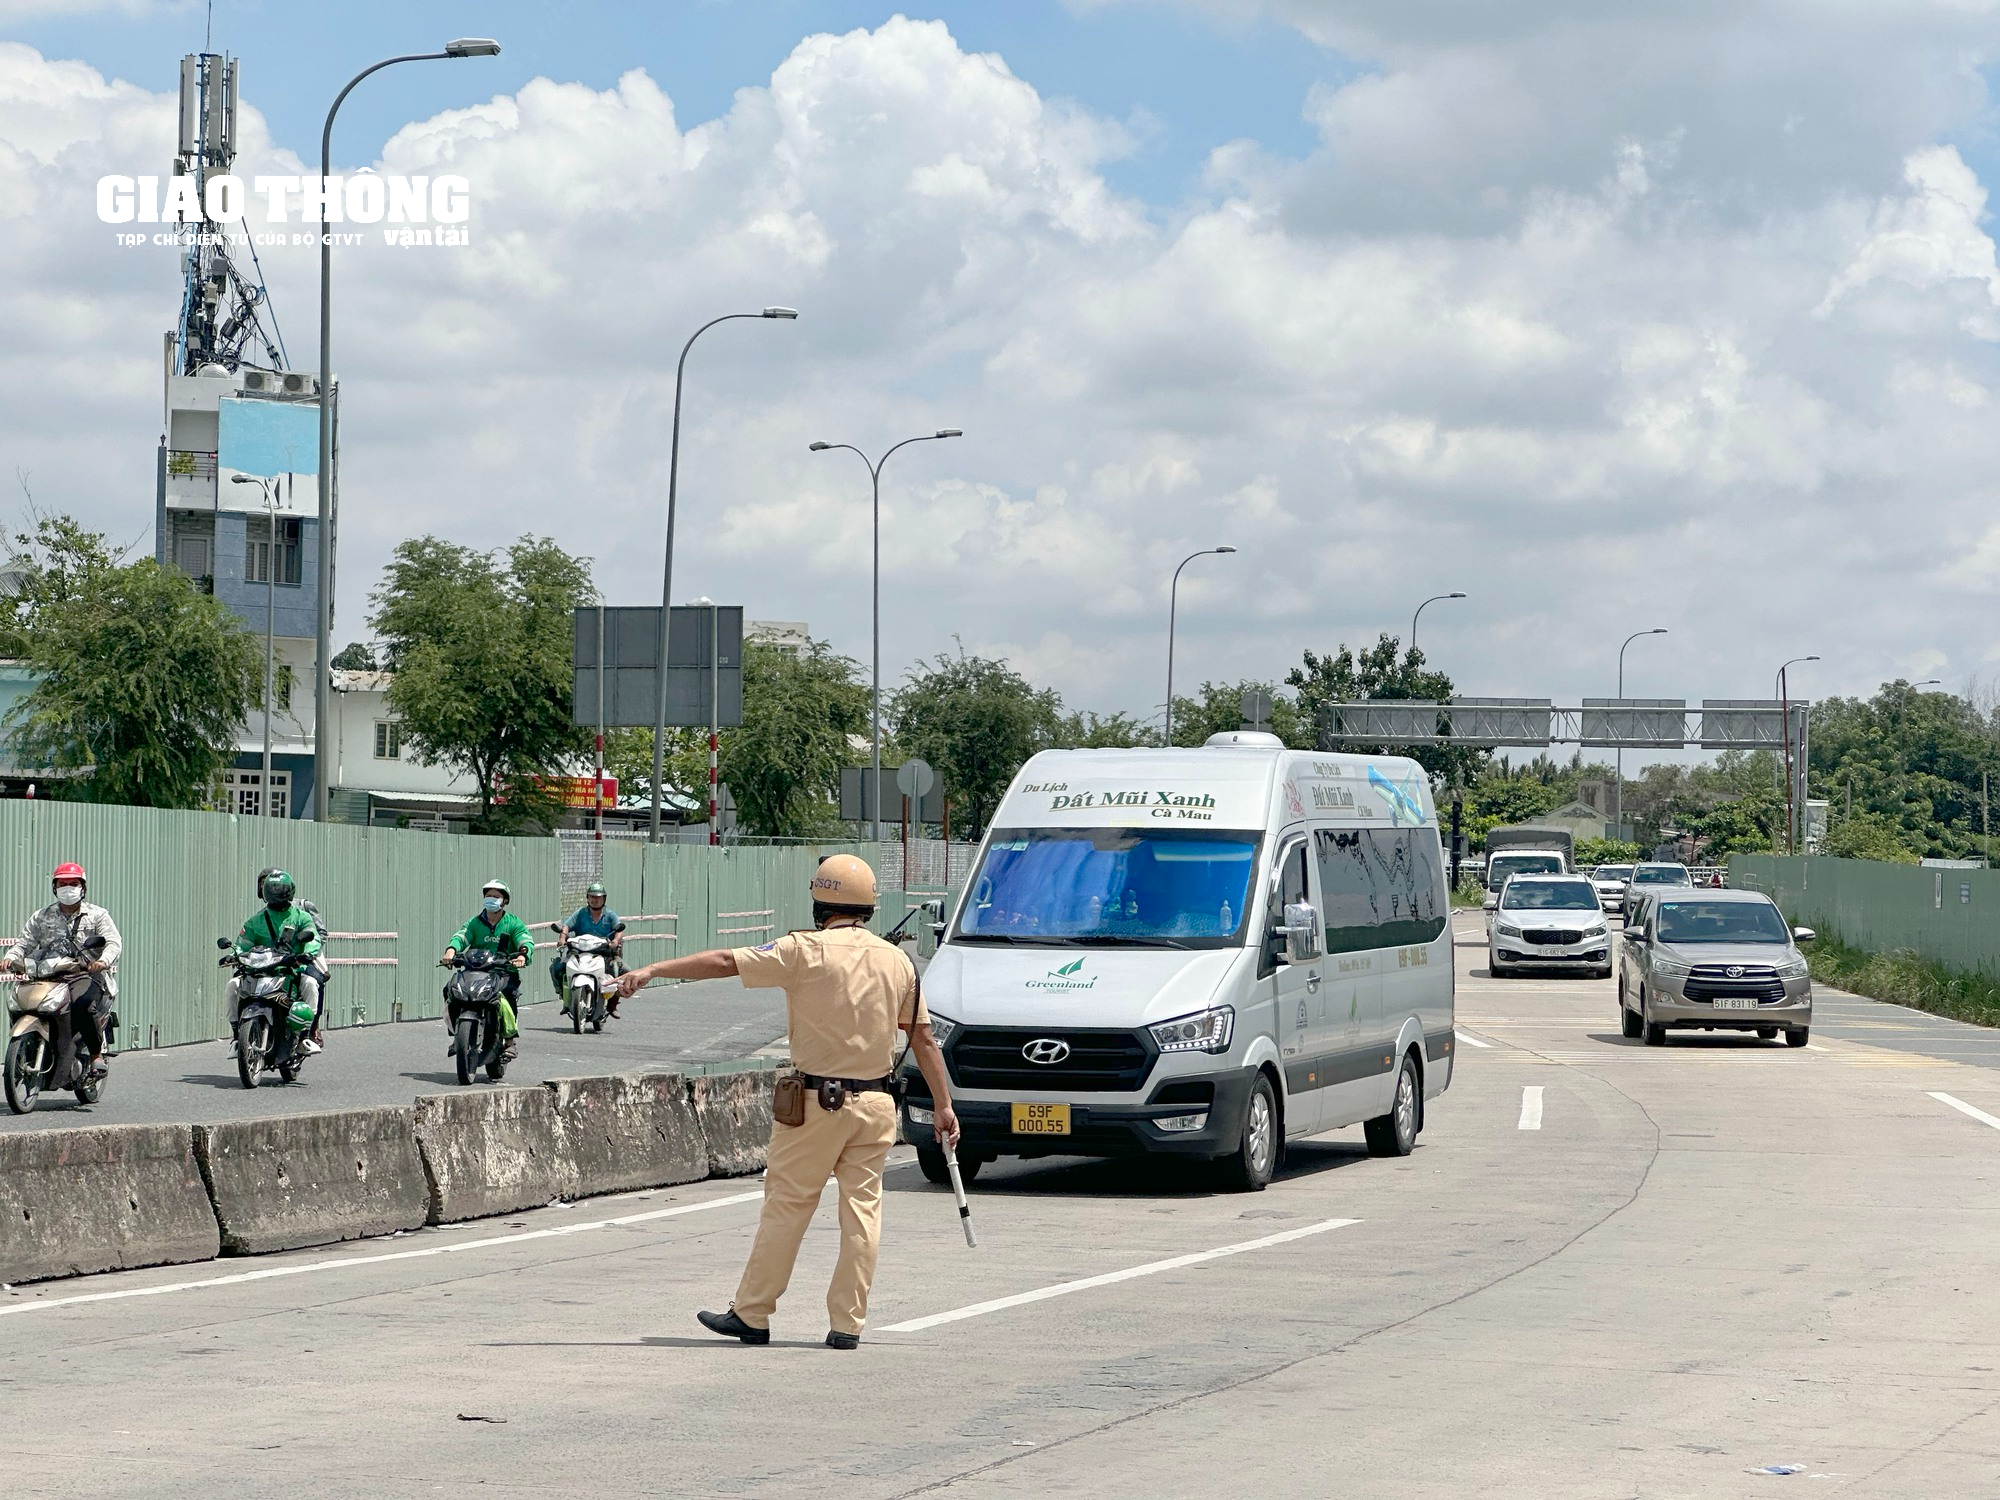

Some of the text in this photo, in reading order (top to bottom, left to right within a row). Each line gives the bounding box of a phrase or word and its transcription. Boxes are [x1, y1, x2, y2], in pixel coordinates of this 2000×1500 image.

[1022, 783, 1068, 793] Du Lịch
[1051, 791, 1216, 810] Đất Mũi Xanh
[1151, 808, 1212, 820] Cà Mau
[814, 878, 842, 891] CSGT
[1025, 980, 1094, 989] Greenland
[1028, 1105, 1053, 1118] 69F
[1018, 1119, 1064, 1132] 000.55
